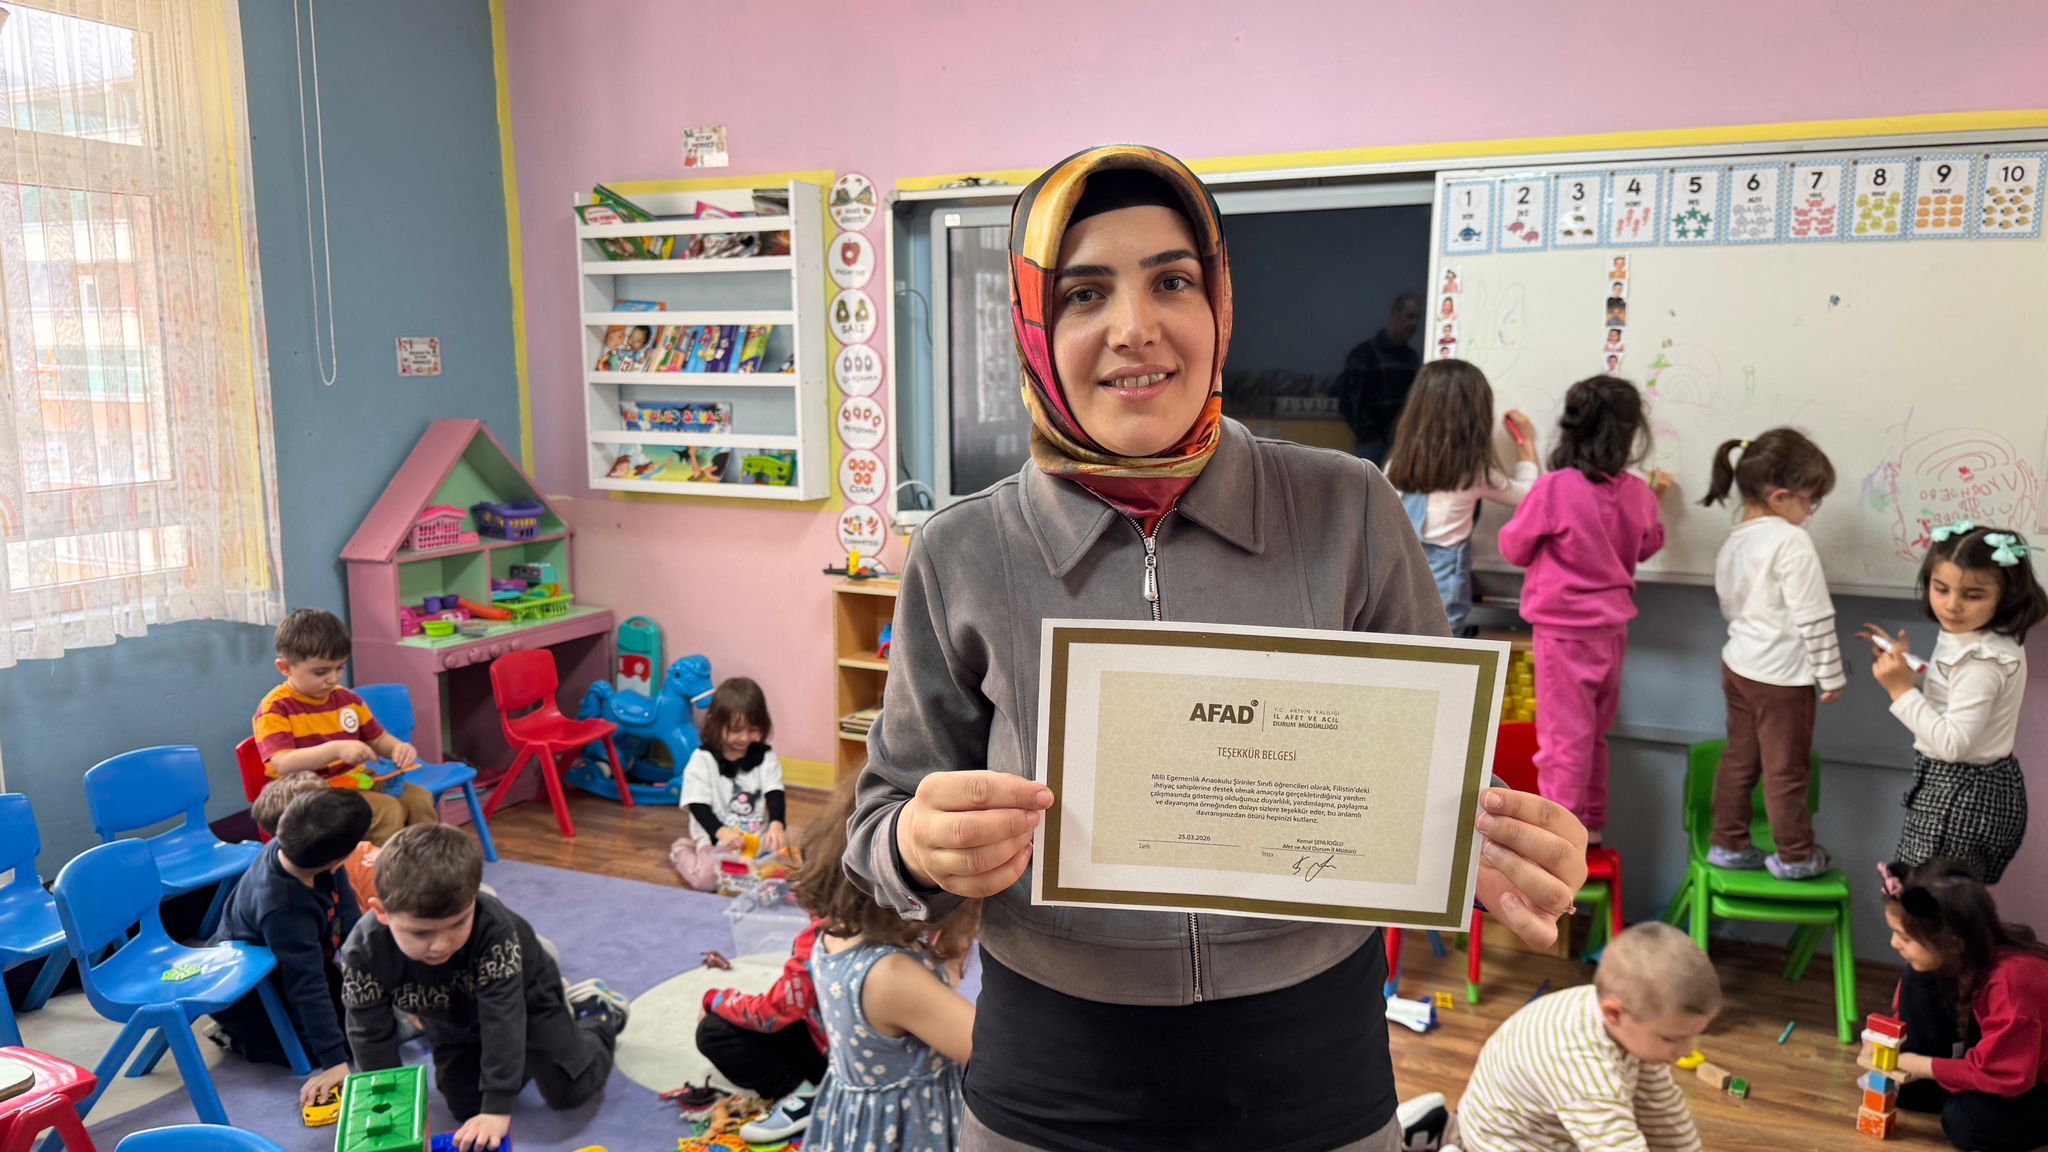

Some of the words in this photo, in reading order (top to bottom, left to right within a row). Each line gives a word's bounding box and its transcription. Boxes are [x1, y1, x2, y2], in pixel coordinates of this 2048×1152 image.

[1747, 174, 1760, 190] 6
[1811, 172, 1823, 189] 7
[1874, 168, 1886, 186] 8
[1937, 165, 1952, 182] 9
[2002, 166, 2024, 182] 10
[1572, 183, 1585, 200] 3
[1626, 178, 1640, 196] 4
[1689, 177, 1702, 194] 5
[1465, 191, 1472, 208] 1
[1518, 187, 1530, 204] 2
[1190, 702, 1254, 724] AFAD
[1218, 747, 1260, 759] TEŞEKKÜR
[1262, 750, 1296, 761] BELGESİ
